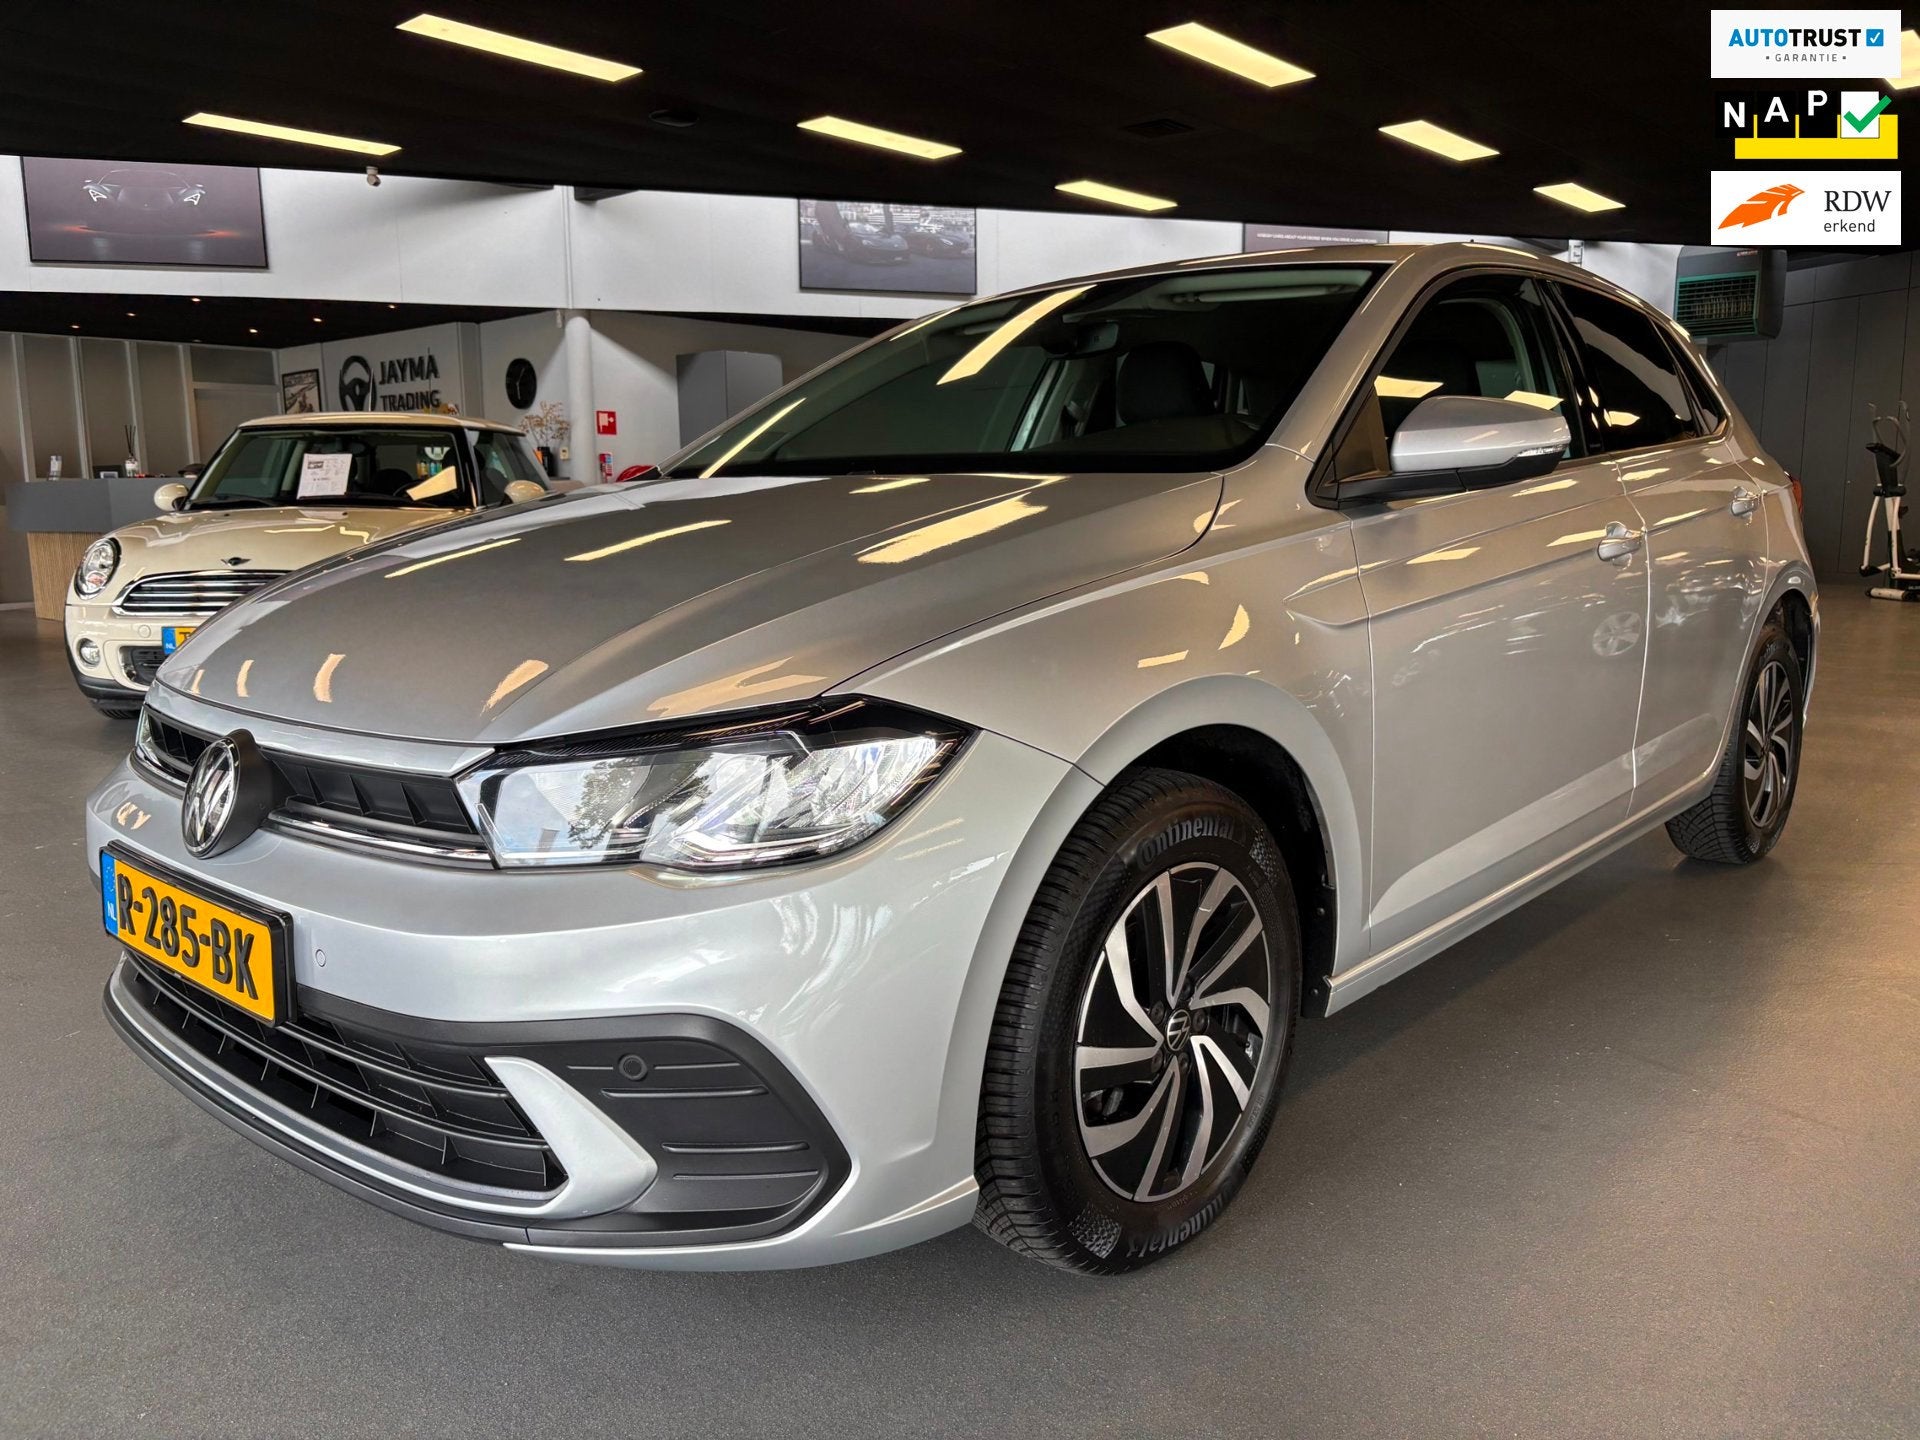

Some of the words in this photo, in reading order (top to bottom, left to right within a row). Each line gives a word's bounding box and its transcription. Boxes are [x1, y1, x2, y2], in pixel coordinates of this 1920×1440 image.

[379, 355, 440, 385] JAYMA
[380, 390, 441, 412] TRADING
[1136, 816, 1234, 868] Continental
[117, 873, 259, 1000] R-285-BK
